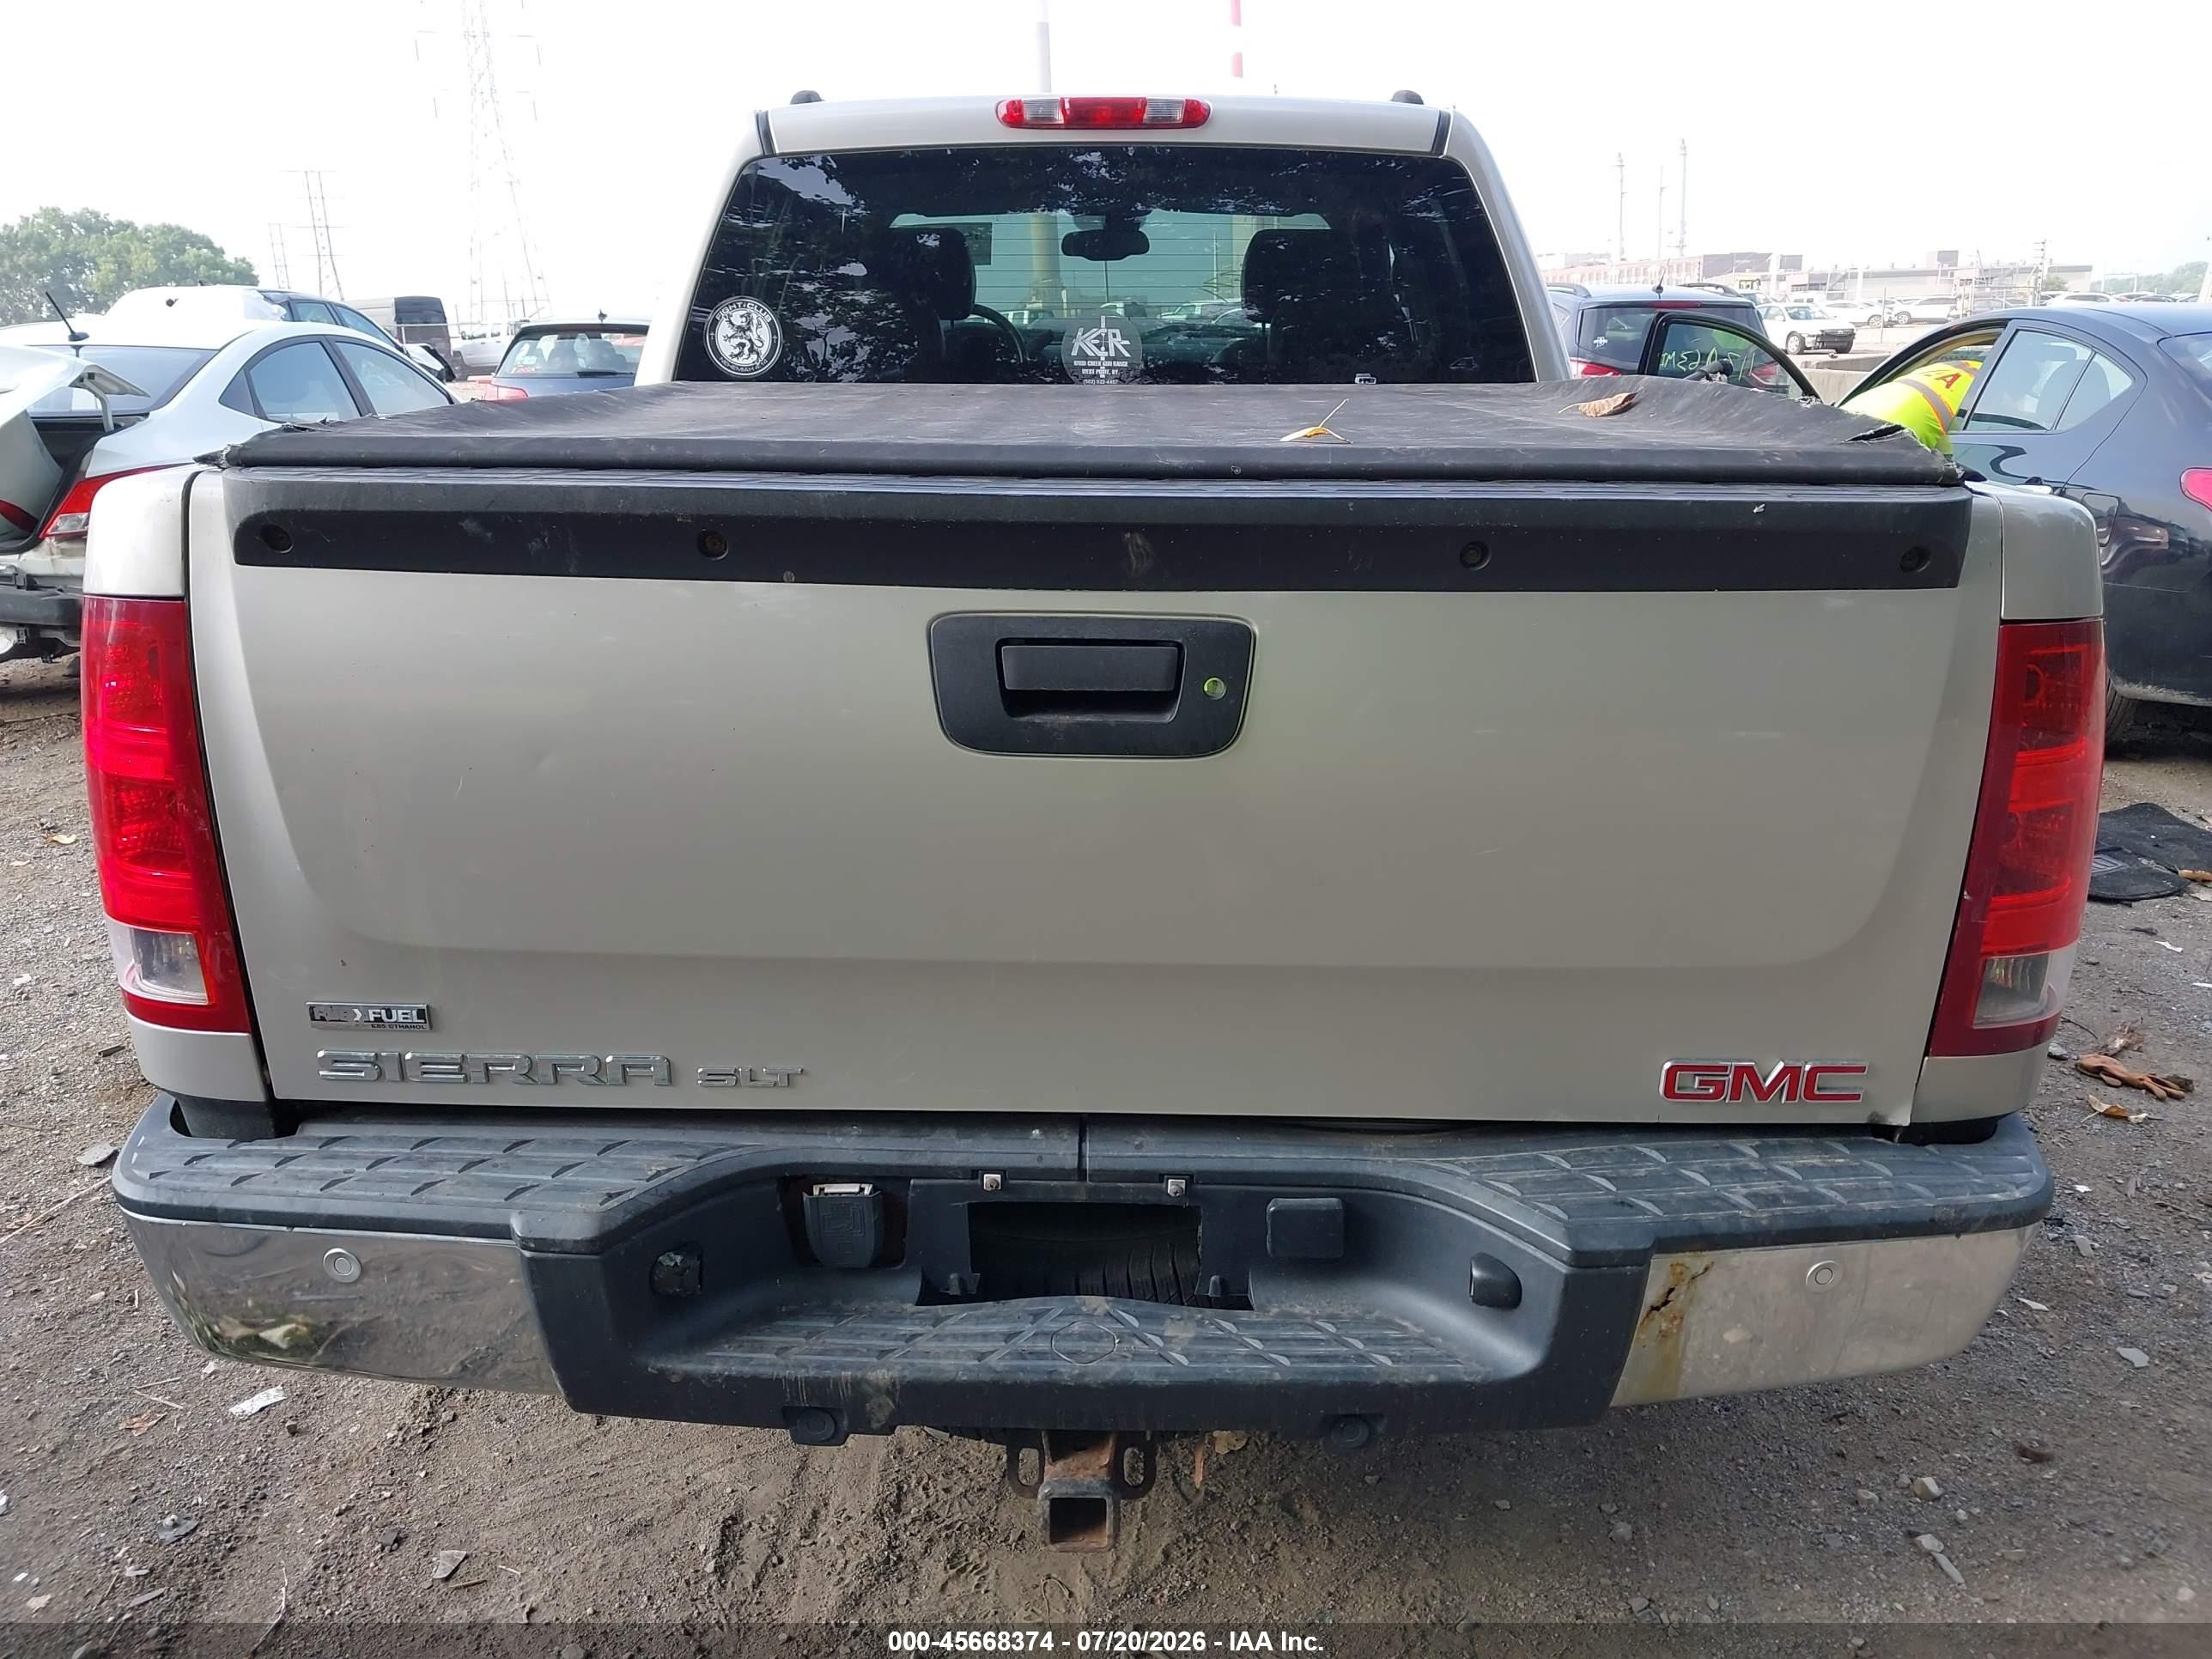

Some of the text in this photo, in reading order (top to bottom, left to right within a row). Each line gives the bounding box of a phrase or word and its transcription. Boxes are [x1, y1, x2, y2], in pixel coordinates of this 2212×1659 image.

[715, 301, 772, 323] FIGHT CLUB
[317, 1049, 803, 1087] SIERRA SLT
[1659, 1059, 1869, 1103] GMC
